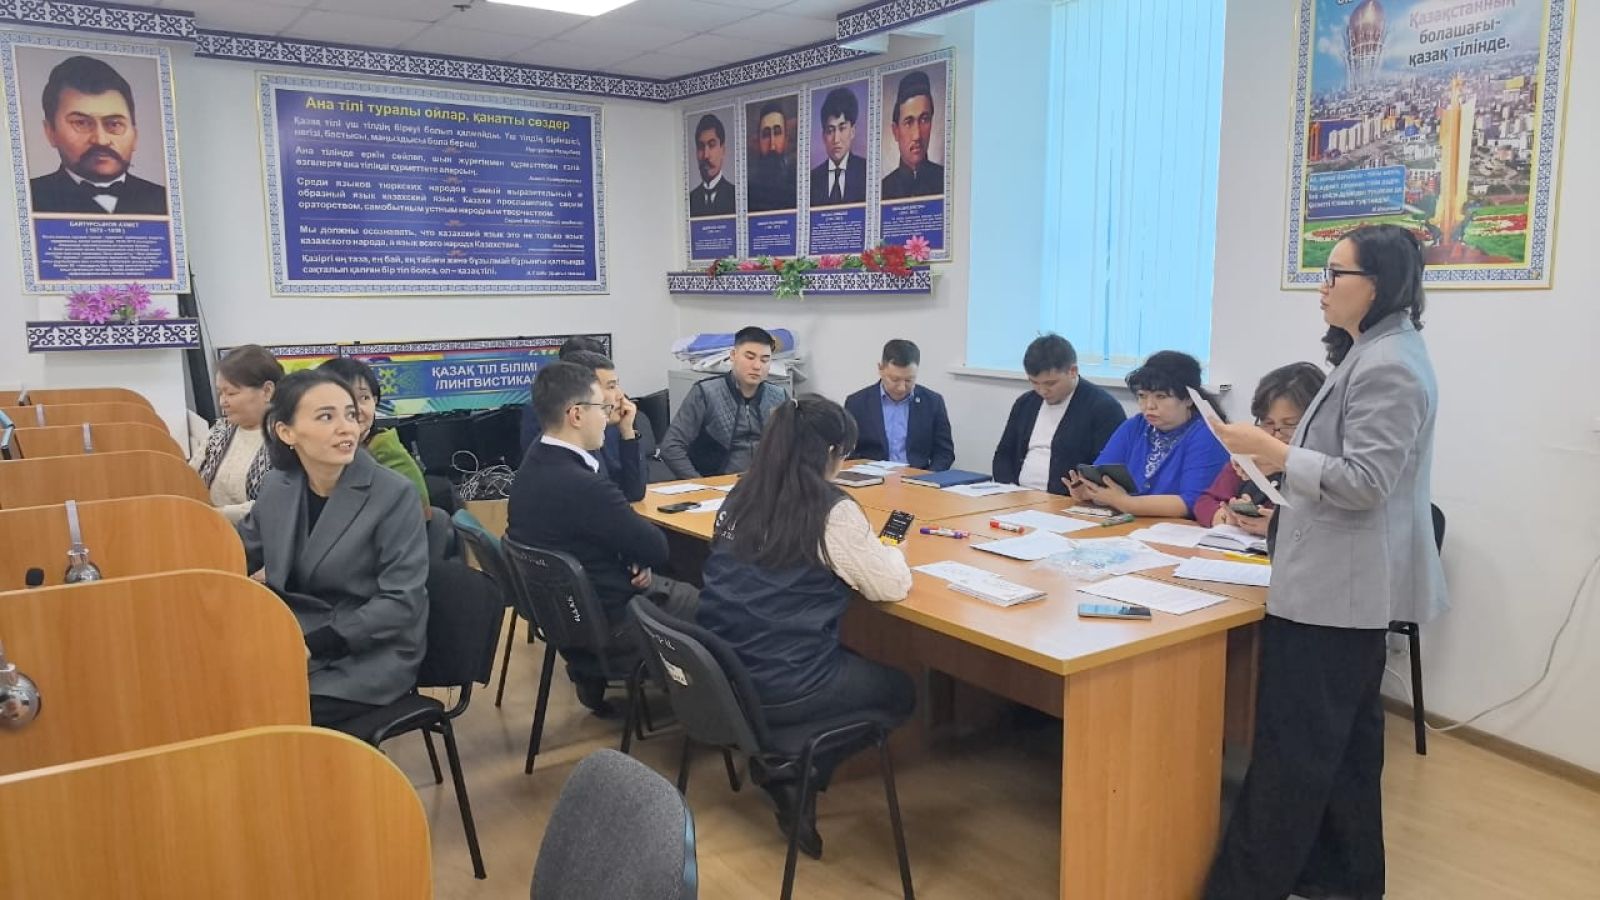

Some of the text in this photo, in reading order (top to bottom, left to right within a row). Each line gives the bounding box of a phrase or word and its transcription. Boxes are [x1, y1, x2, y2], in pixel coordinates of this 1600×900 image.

[1409, 0, 1517, 28] Қазақстанның
[1419, 20, 1501, 45] болашағы-
[1409, 37, 1510, 67] қазақ тілінде.
[305, 96, 334, 110] Ана
[338, 99, 364, 112] тілі
[367, 104, 421, 117] туралы
[473, 111, 525, 126] қанатты
[528, 118, 571, 132] сөздер
[432, 362, 537, 378] ҚАЗАҚ ТІЛ БІЛІМІ
